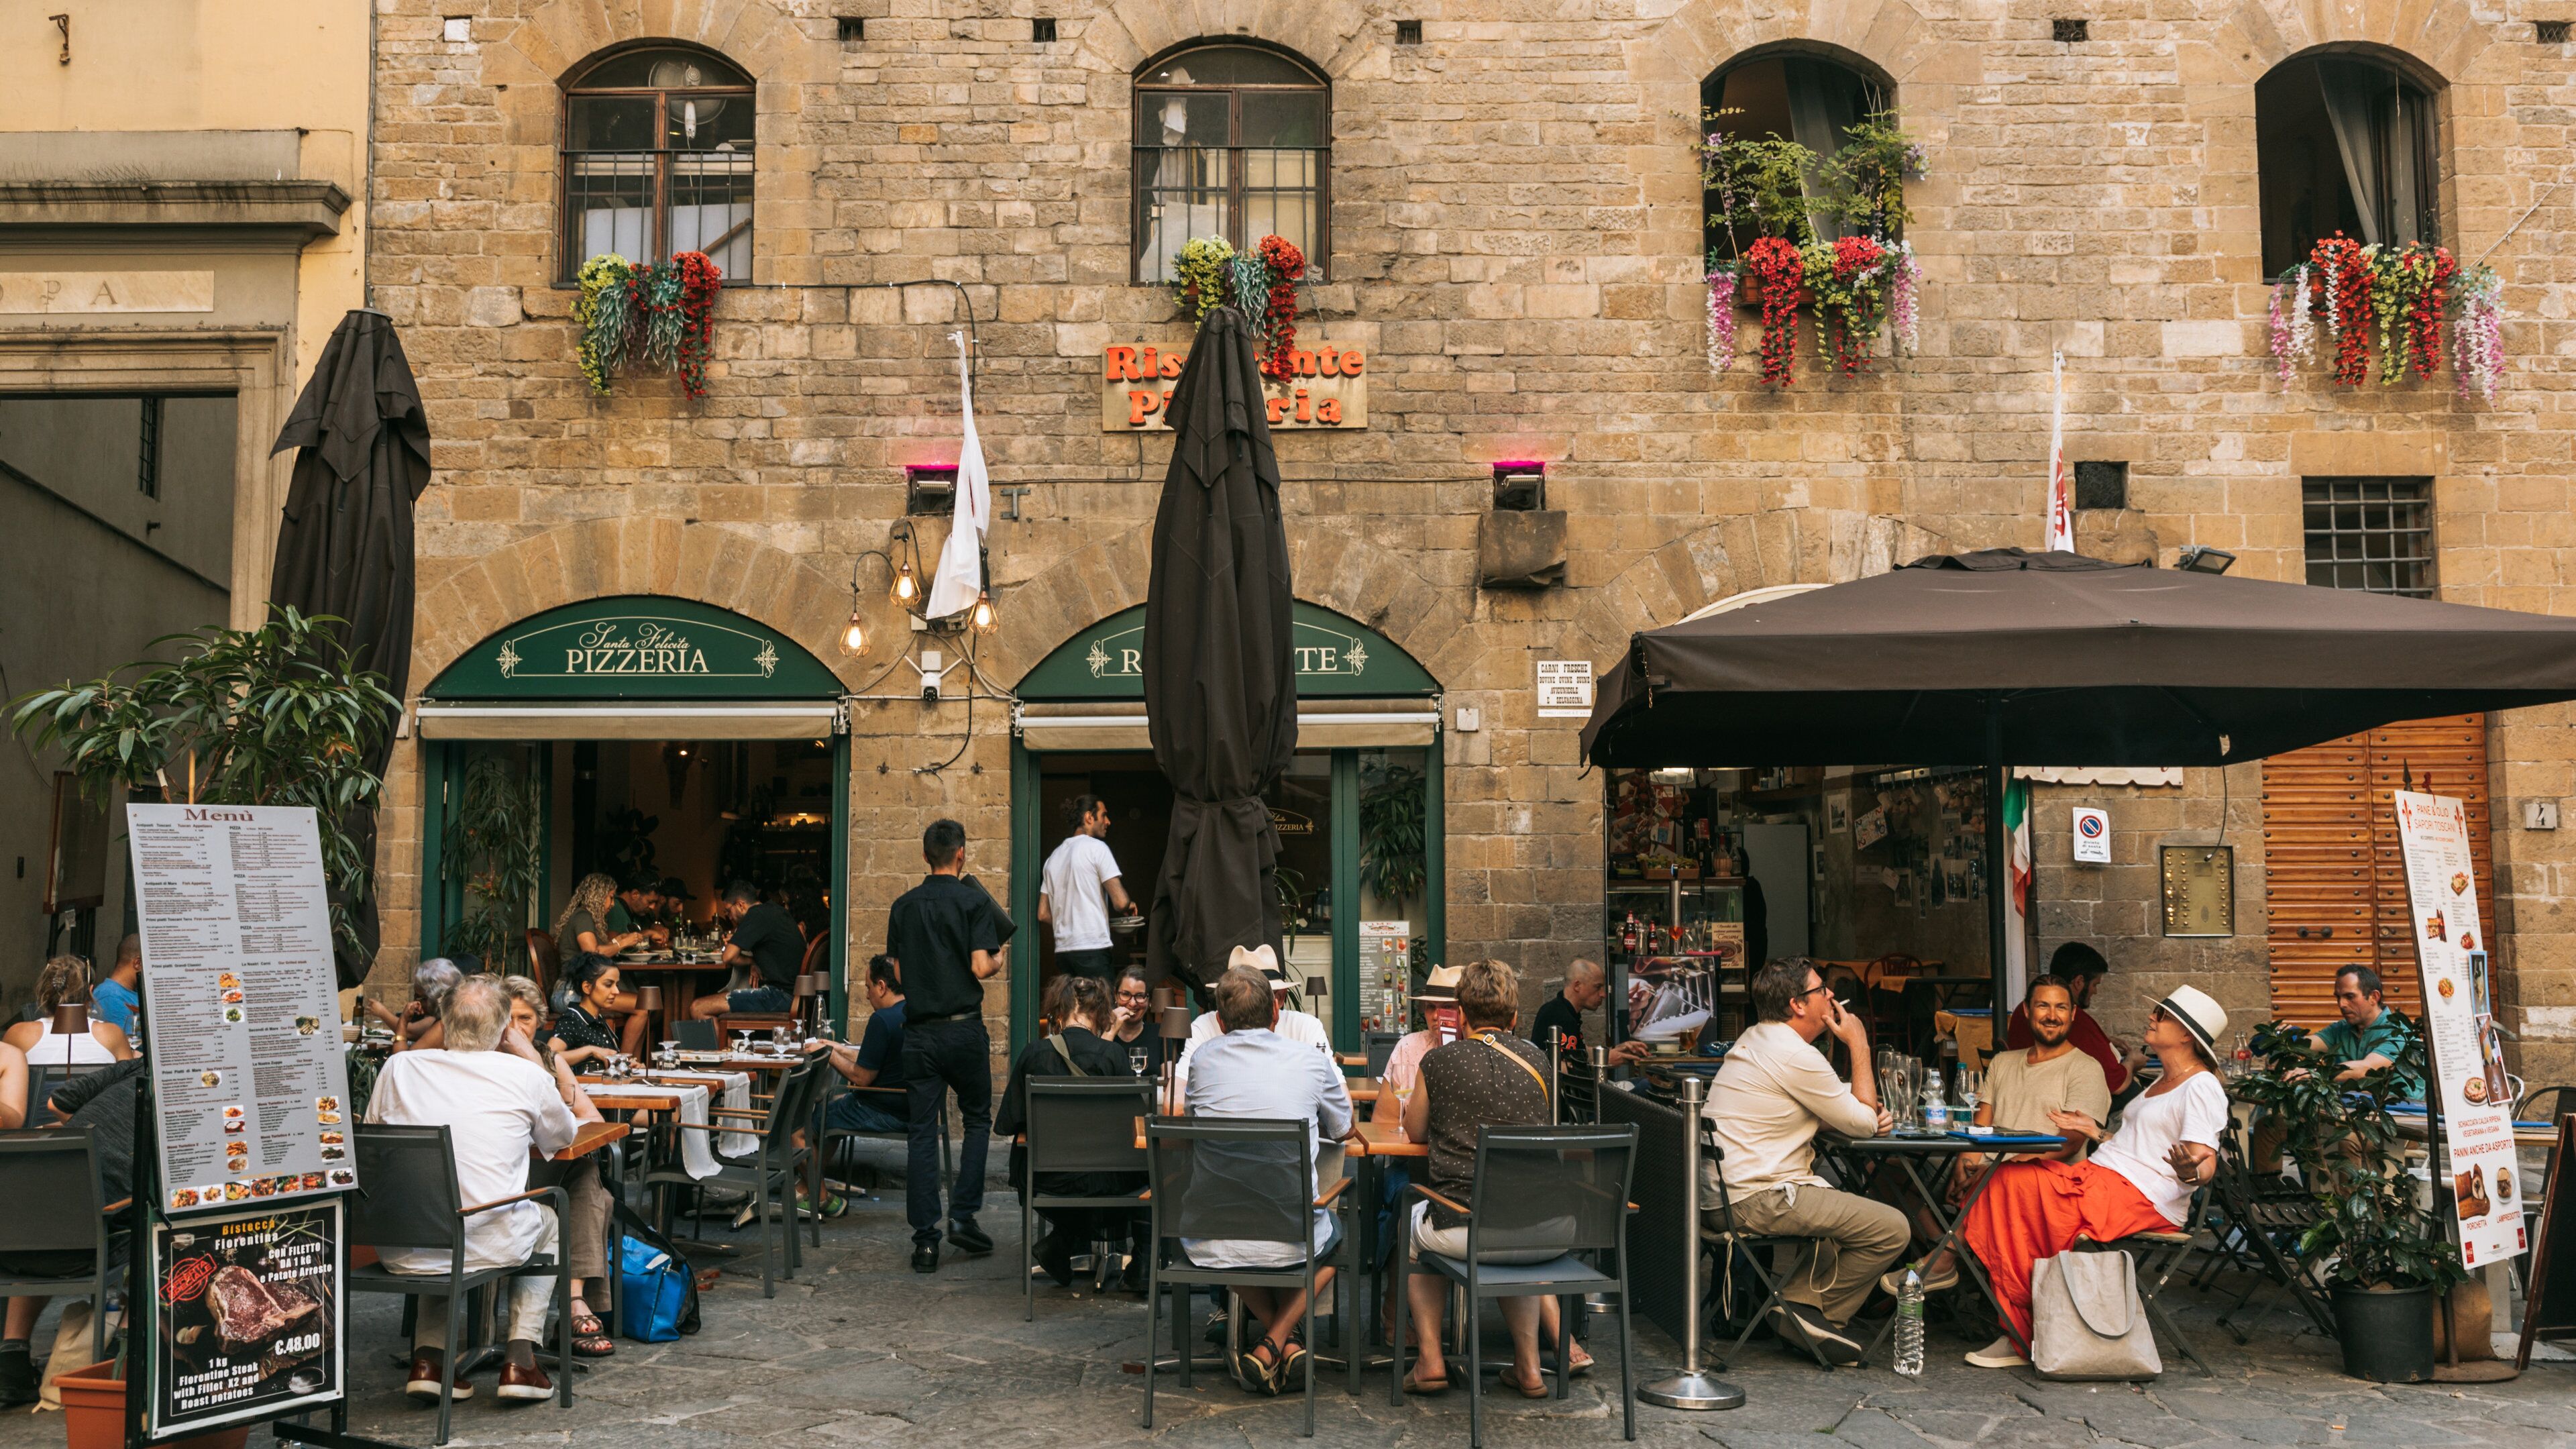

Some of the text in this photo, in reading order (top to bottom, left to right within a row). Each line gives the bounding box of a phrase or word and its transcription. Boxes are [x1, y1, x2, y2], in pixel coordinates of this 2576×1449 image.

[579, 622, 691, 650] Santa Felicita
[566, 649, 710, 674] PIZZERIA
[1541, 663, 1588, 674] CARNI FRESCHE
[184, 808, 254, 822] Menù
[2416, 804, 2431, 815] PANE
[2436, 806, 2449, 817] OLIO
[2535, 803, 2546, 826] 4
[2414, 818, 2456, 833] SAPORI TOSCANI
[2454, 1138, 2512, 1159] PANINI ANCHE DA ASPORTO
[2467, 1219, 2487, 1230] PORCHETTA
[2497, 1210, 2520, 1224] LAMPREDOTTO
[222, 1219, 276, 1236] Bistecca
[215, 1231, 279, 1250] Fiorentina
[268, 1242, 321, 1260] CON FILETTO
[280, 1258, 291, 1269] DA
[294, 1256, 299, 1266] 1
[166, 1260, 209, 1293] OFFERTA
[168, 1263, 213, 1300] SPECIALE
[260, 1263, 332, 1283] e Patate Arrosto
[275, 1332, 320, 1356] €.48,00
[209, 1356, 227, 1368] 1 kg
[231, 1361, 258, 1376] Steak
[173, 1373, 260, 1399] with Fillet X2 and
[181, 1386, 254, 1410] Roast potatoes
